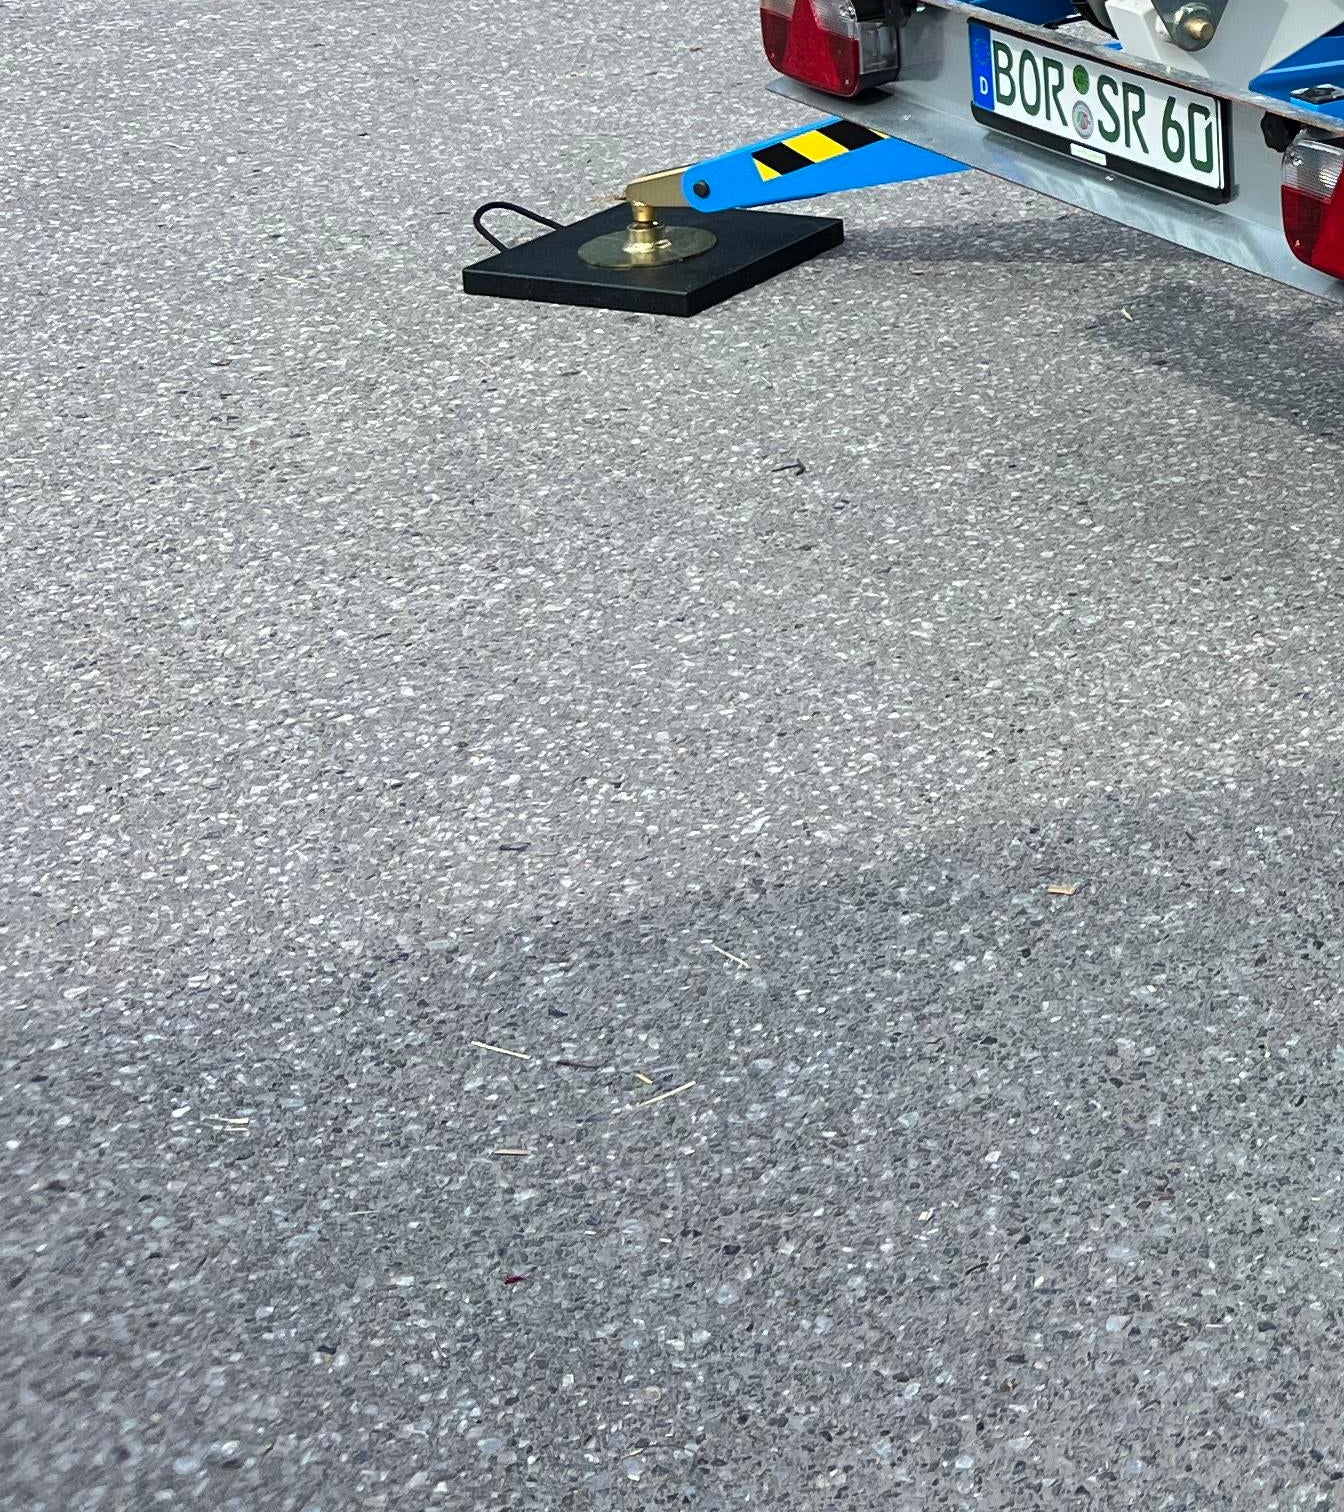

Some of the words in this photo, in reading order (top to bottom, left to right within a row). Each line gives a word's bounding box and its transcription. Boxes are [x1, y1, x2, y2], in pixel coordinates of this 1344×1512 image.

[979, 75, 988, 96] D
[992, 39, 1068, 127] BOR
[1096, 74, 1150, 155] SR
[1161, 96, 1214, 174] 60
